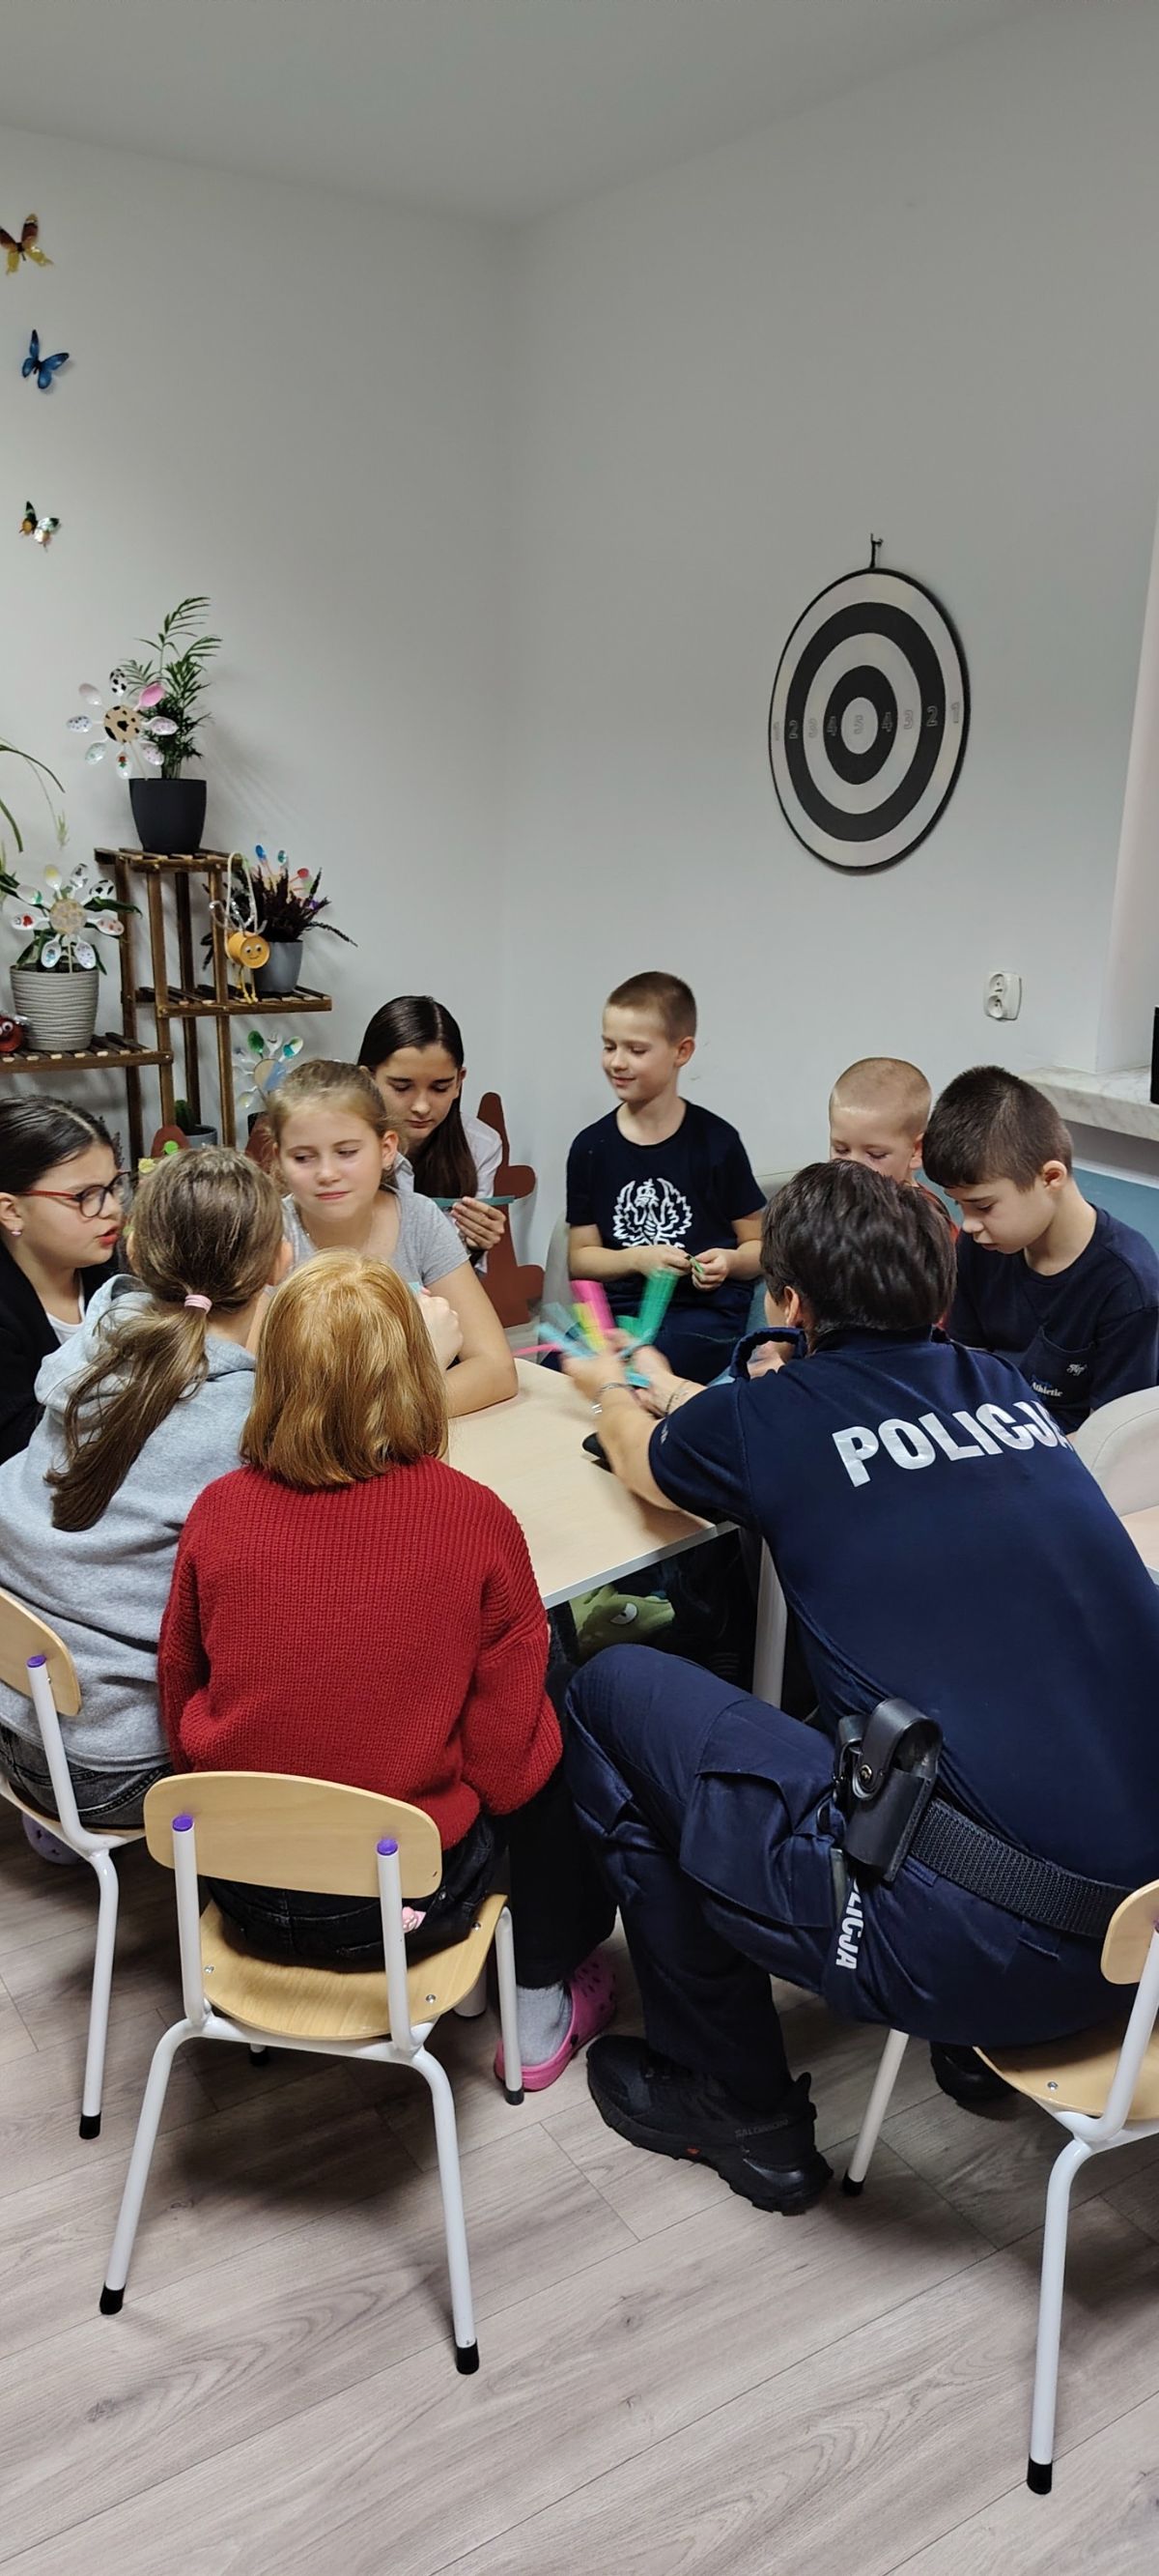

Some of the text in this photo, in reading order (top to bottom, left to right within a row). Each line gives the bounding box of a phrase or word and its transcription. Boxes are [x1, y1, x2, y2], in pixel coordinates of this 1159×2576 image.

[788, 719, 799, 740] 2
[881, 711, 892, 731] 4
[903, 709, 914, 730] 3
[927, 704, 938, 727] 2
[835, 1878, 864, 1970] LICJA
